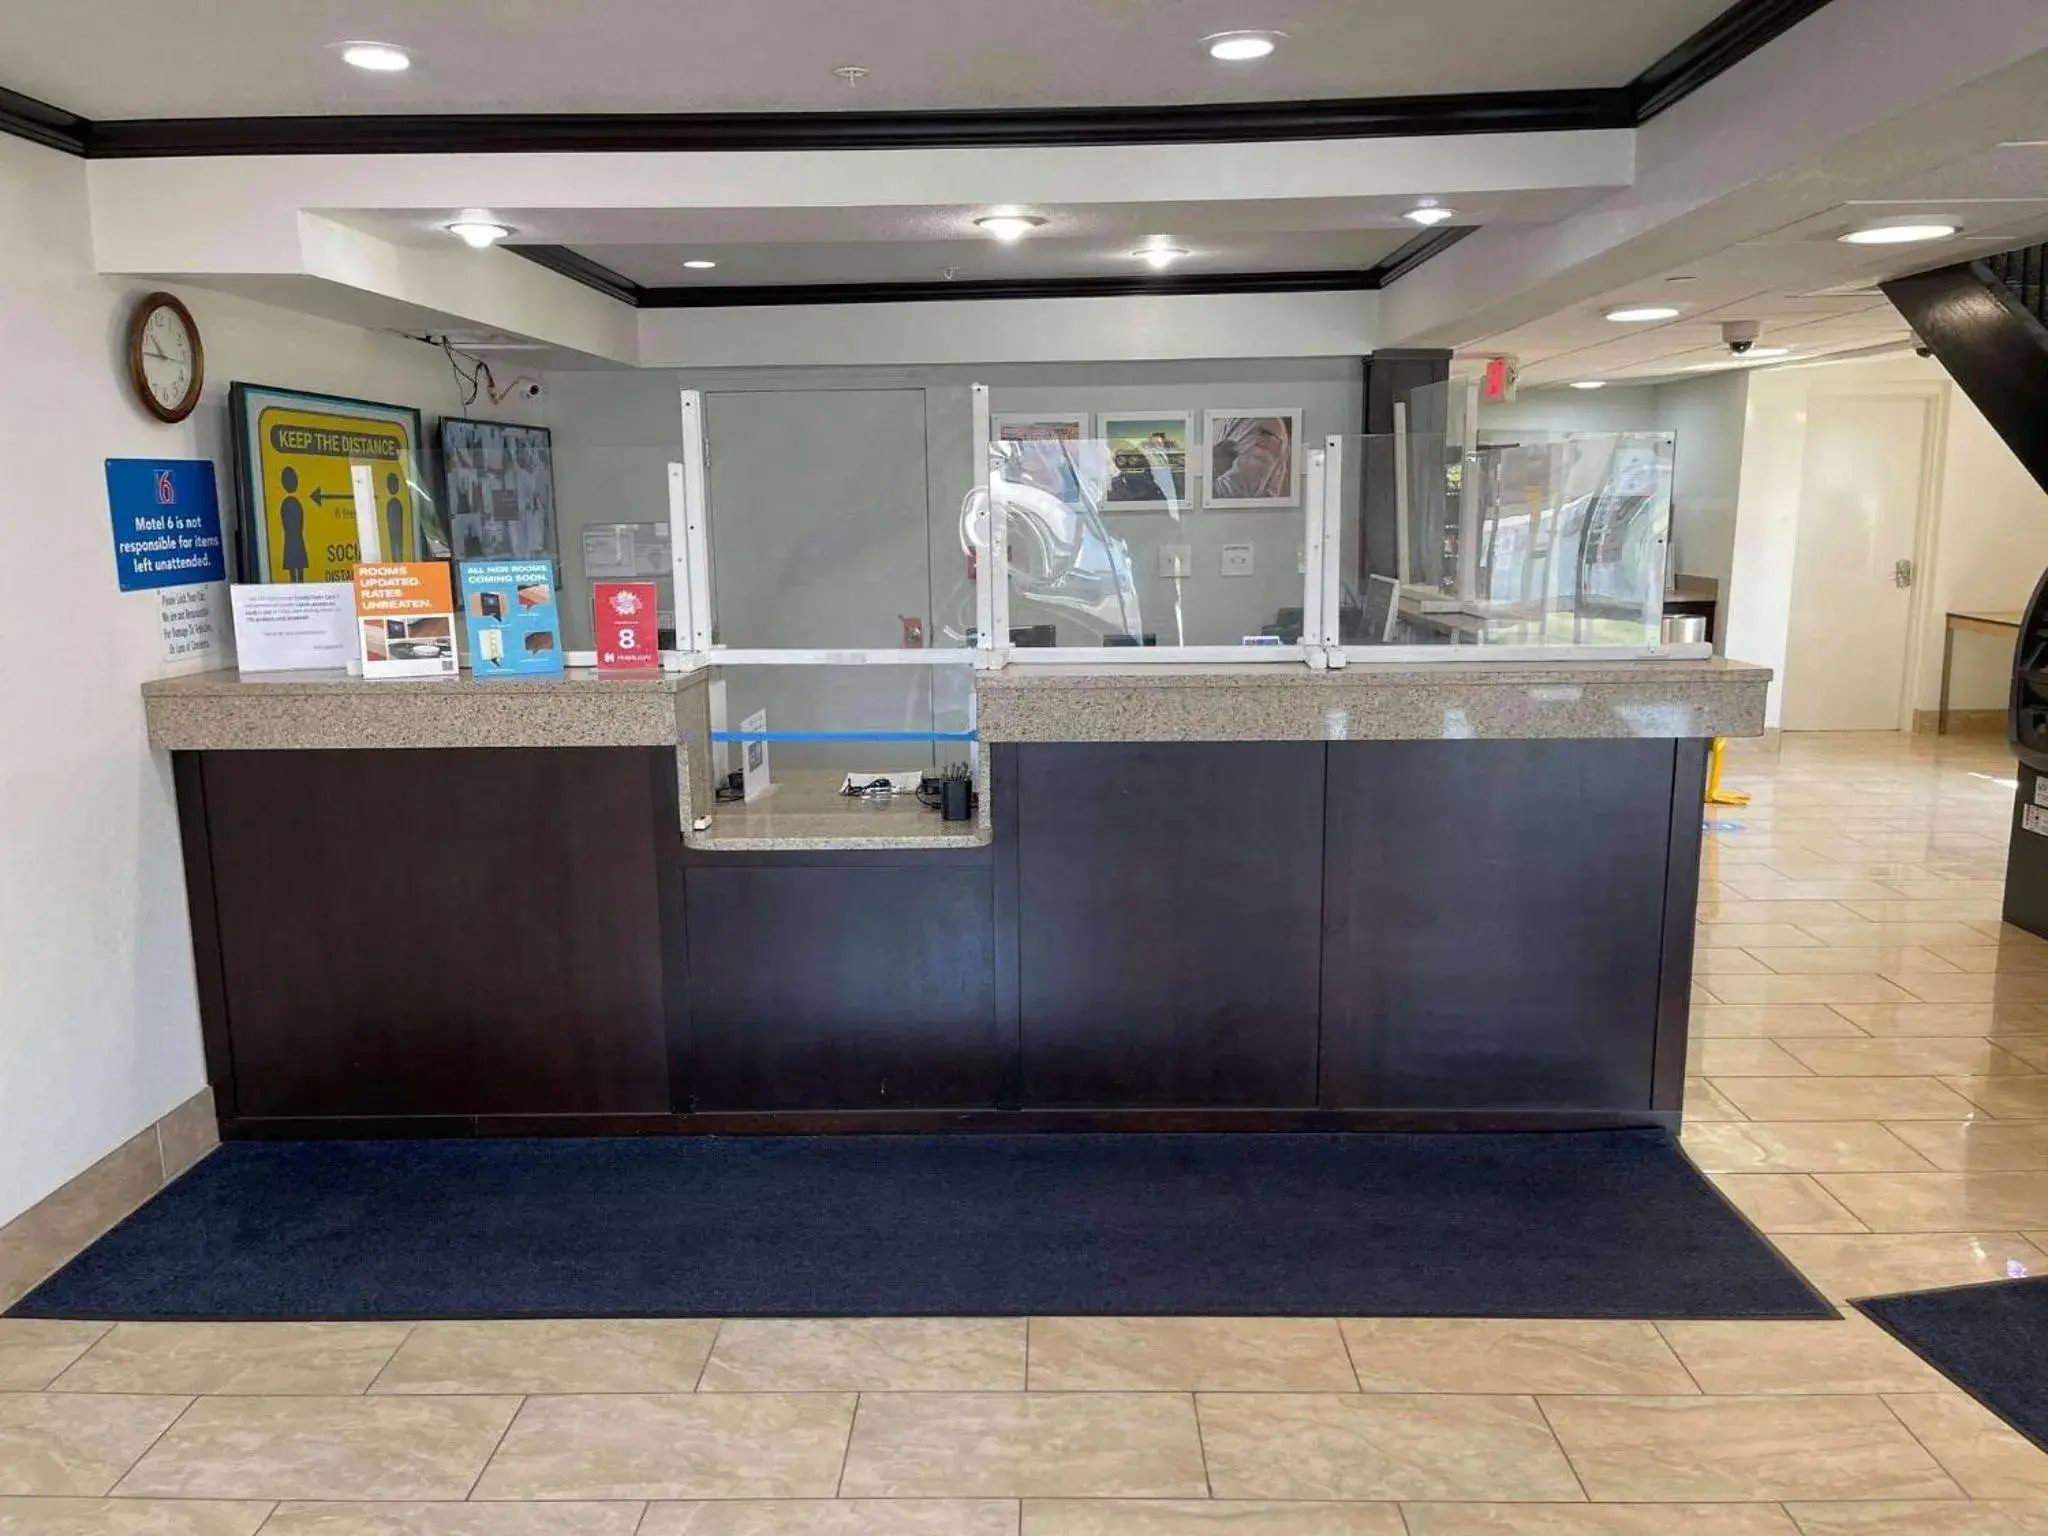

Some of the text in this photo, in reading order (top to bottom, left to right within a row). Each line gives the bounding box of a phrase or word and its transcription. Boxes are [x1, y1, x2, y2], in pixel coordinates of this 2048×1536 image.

[280, 429, 312, 449] KEEP
[314, 432, 340, 453] THE
[135, 516, 202, 531] Motel 6 is not
[120, 534, 219, 555] responsible for items
[327, 544, 362, 563] SOCI
[133, 552, 212, 573] left unattended.
[358, 566, 408, 576] ROOMS
[467, 567, 485, 575] ALL
[468, 575, 513, 584] COMING
[361, 588, 402, 599] RATES
